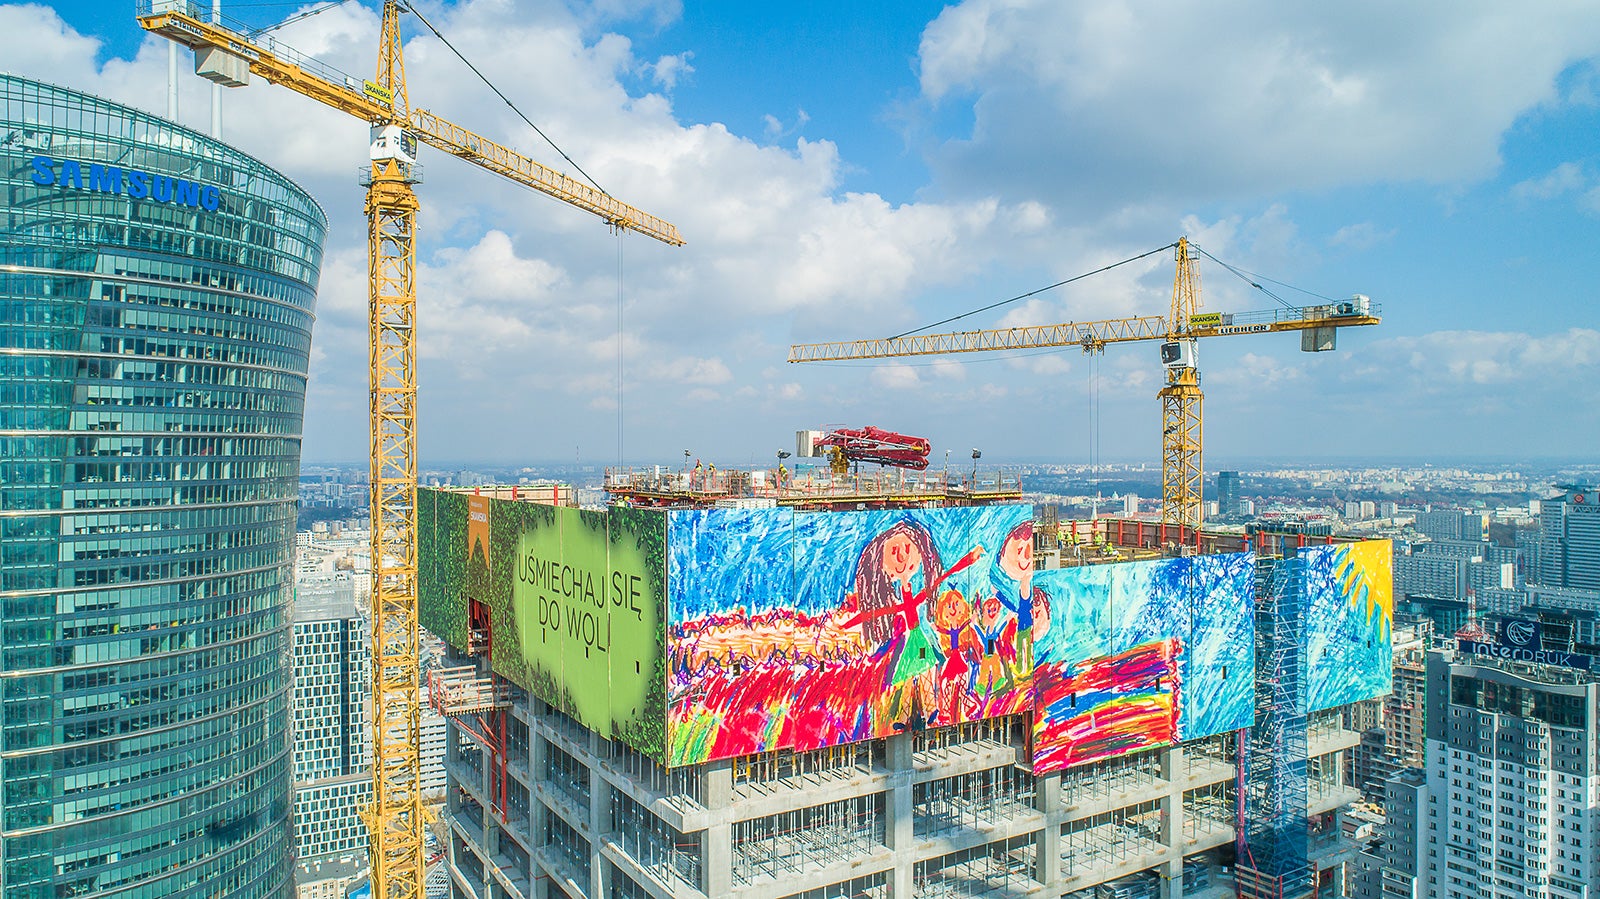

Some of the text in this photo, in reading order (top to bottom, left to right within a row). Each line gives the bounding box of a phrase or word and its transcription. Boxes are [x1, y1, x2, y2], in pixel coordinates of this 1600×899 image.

[365, 83, 391, 100] SKANSKA
[31, 156, 220, 211] SAMSUNG
[1191, 315, 1220, 324] SKANSKA
[1220, 325, 1267, 334] LIEBHERR
[518, 548, 641, 621] UŚMIECHAJ SIĘ
[539, 595, 560, 631] DO
[1472, 642, 1572, 667] interDRUK
